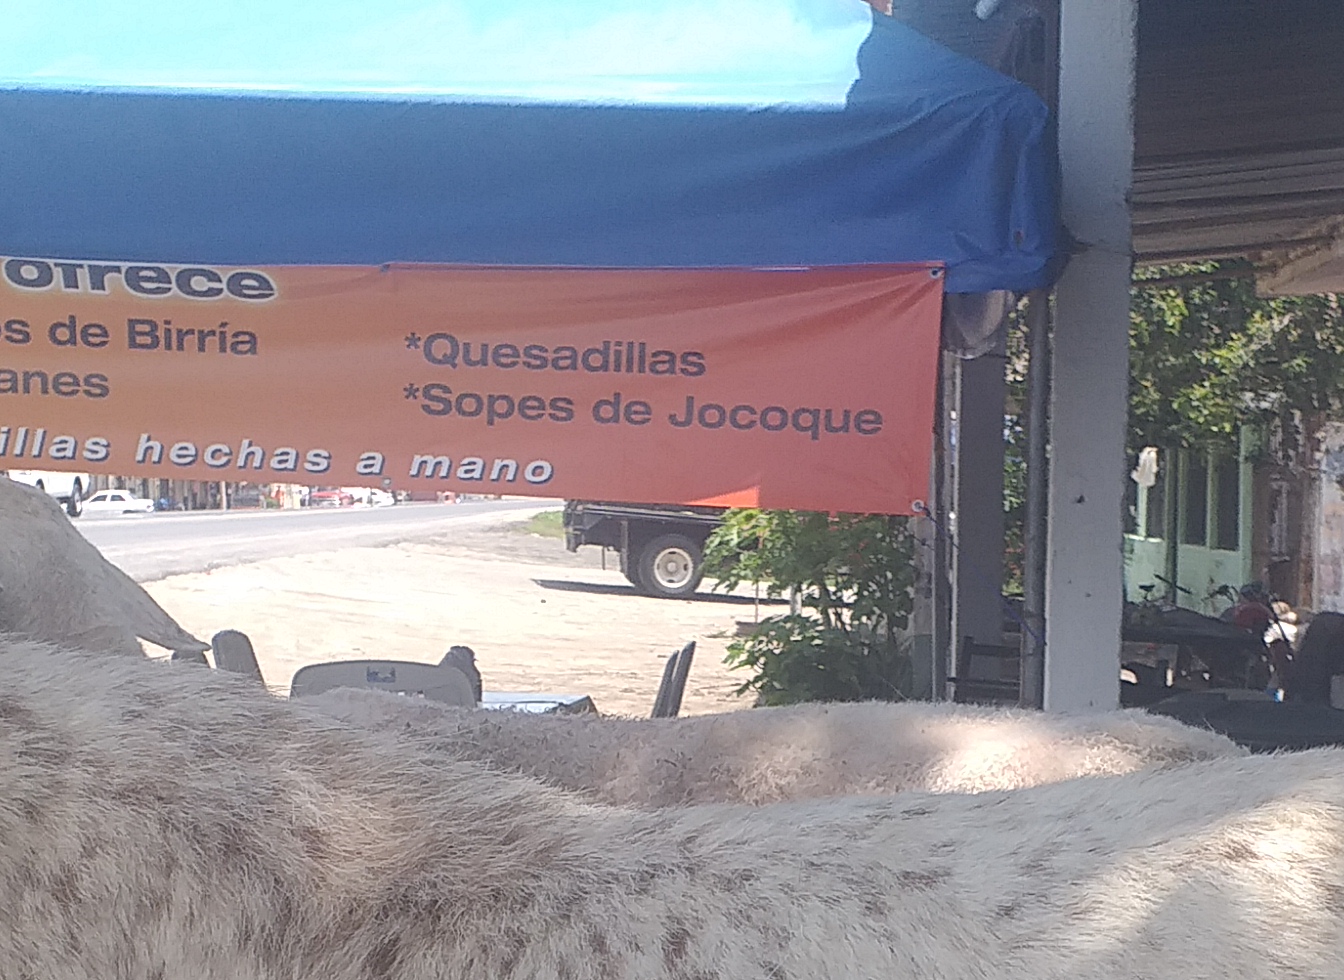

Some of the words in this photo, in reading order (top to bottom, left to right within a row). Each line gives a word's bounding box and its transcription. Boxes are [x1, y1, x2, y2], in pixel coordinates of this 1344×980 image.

[5, 258, 275, 299] ofrece
[48, 315, 110, 348] de
[128, 318, 258, 356] Birría
[592, 392, 652, 426] de
[668, 395, 883, 441] Jocoque
[136, 433, 331, 473] hechas
[355, 451, 384, 476] a
[409, 453, 555, 484] mano
